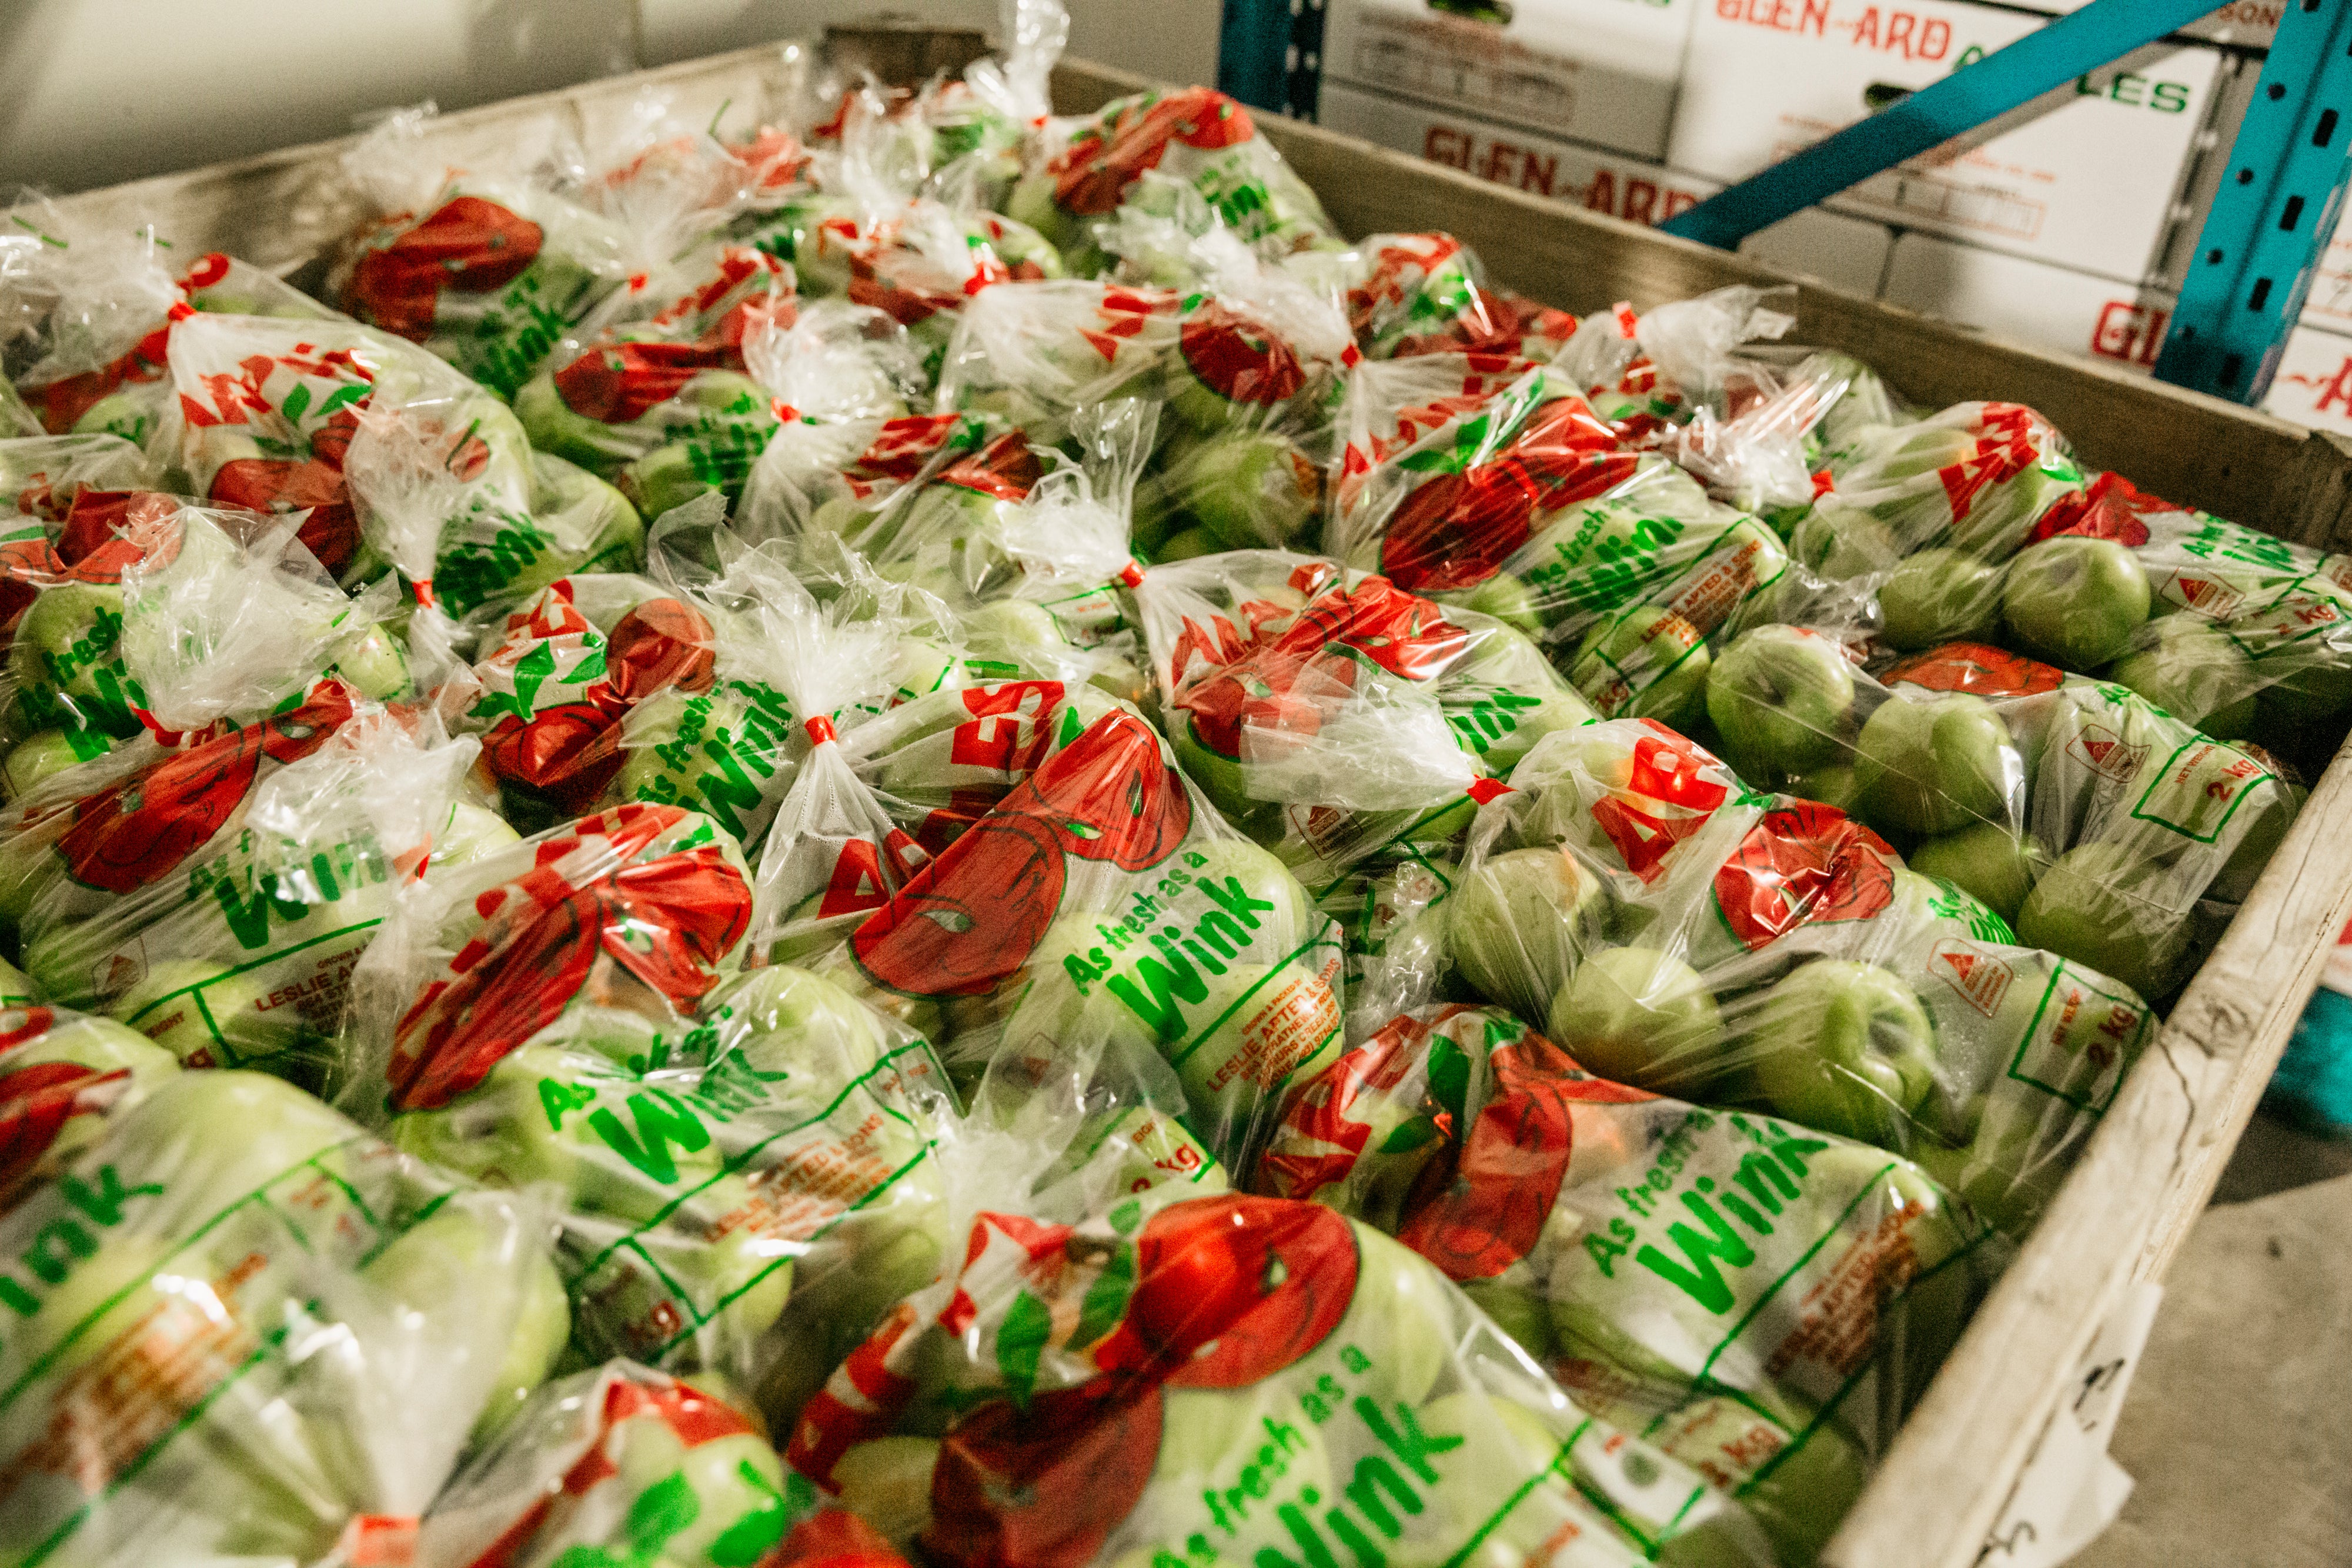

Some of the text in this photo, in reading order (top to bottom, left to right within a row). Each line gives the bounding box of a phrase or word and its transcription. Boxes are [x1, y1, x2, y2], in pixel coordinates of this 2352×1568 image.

[1682, 571, 1722, 609] APTED
[2294, 604, 2337, 626] kg
[676, 679, 793, 844] Wink
[2174, 763, 2193, 785] NET
[2206, 756, 2263, 804] 2 kg
[1063, 851, 1209, 997] As fresh as a
[1105, 876, 1274, 1040] Wink
[253, 971, 332, 1012] LESLIE
[1241, 1010, 1268, 1036] GROWN
[1271, 983, 1296, 1007] PACKED
[1205, 957, 1344, 1092] LESLIE APTED & SONS
[1297, 1014, 1328, 1042] CREEK
[1153, 1142, 1201, 1174] kg
[1582, 1218, 1636, 1279] As
[1615, 1131, 1699, 1218] fresh
[1635, 1111, 1830, 1316] Wink
[1202, 1416, 1309, 1537] fresh
